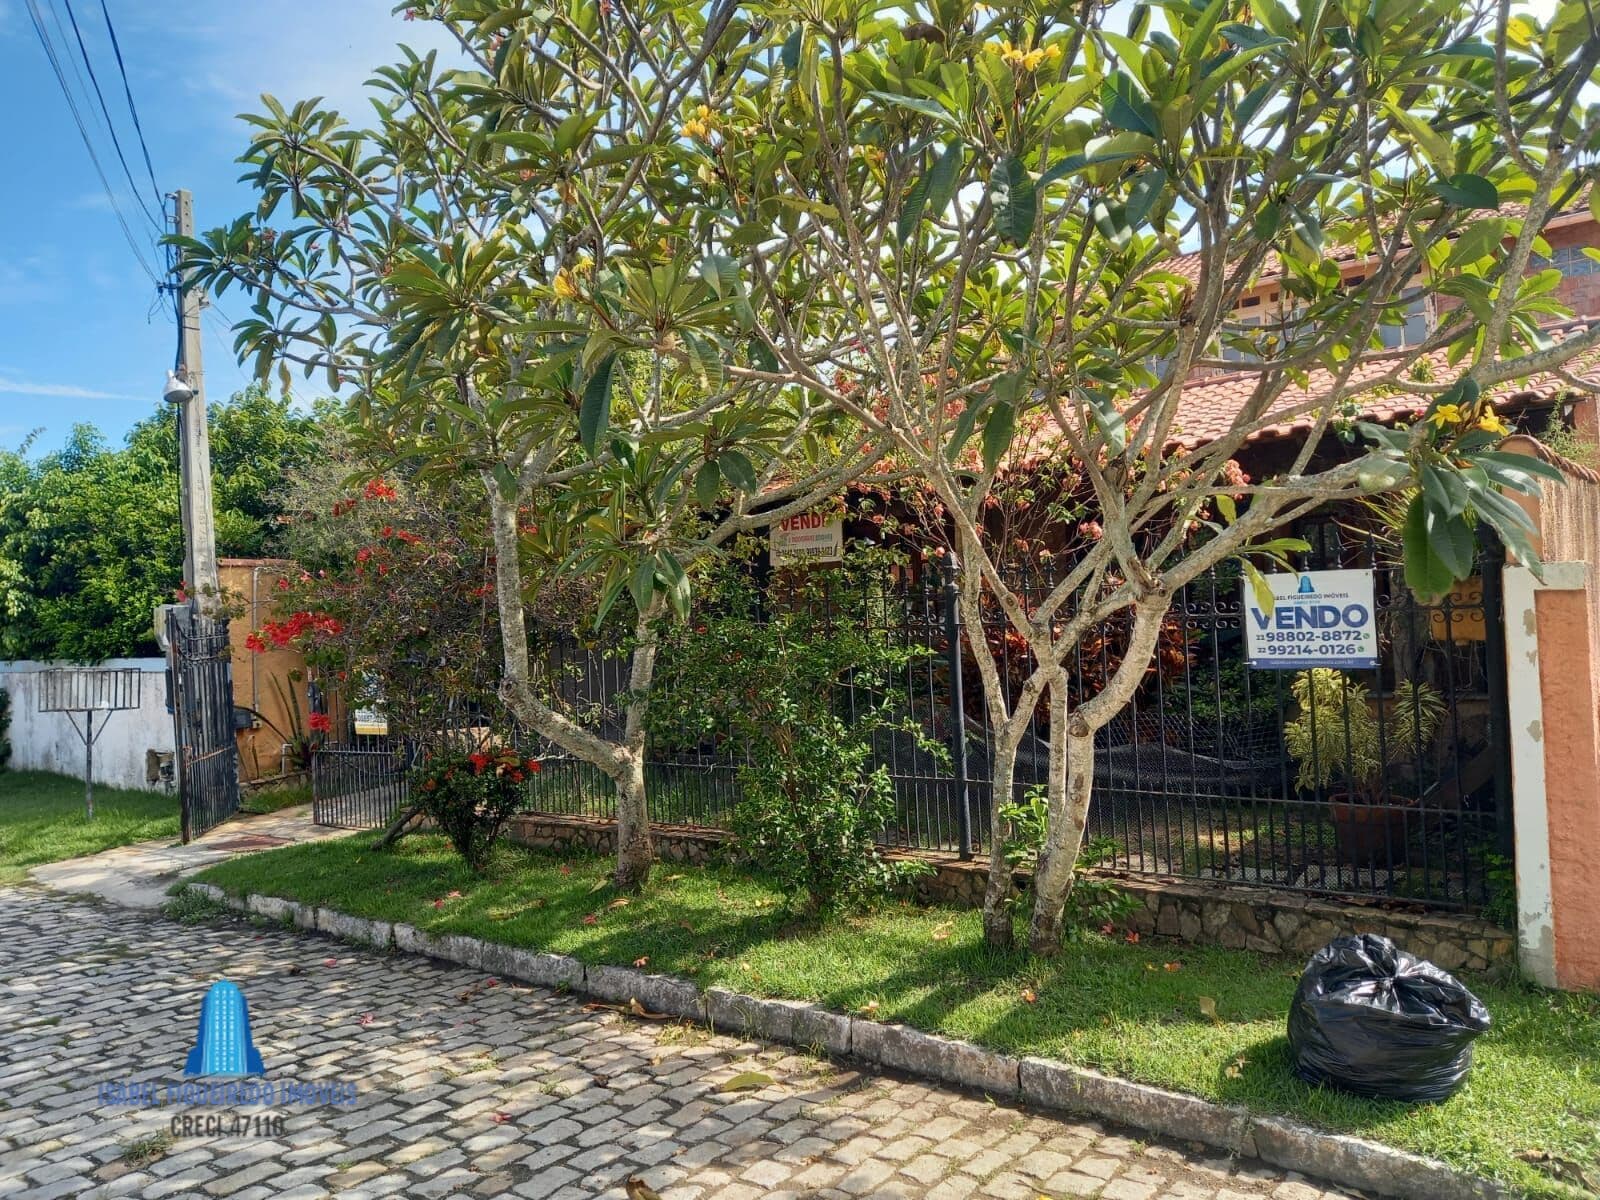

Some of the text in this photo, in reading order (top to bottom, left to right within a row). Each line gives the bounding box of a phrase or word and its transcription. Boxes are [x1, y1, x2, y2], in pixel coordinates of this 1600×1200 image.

[1250, 604, 1369, 630] VENDO
[1265, 631, 1362, 642] 98802-8872
[1268, 644, 1356, 655] 99214-0126
